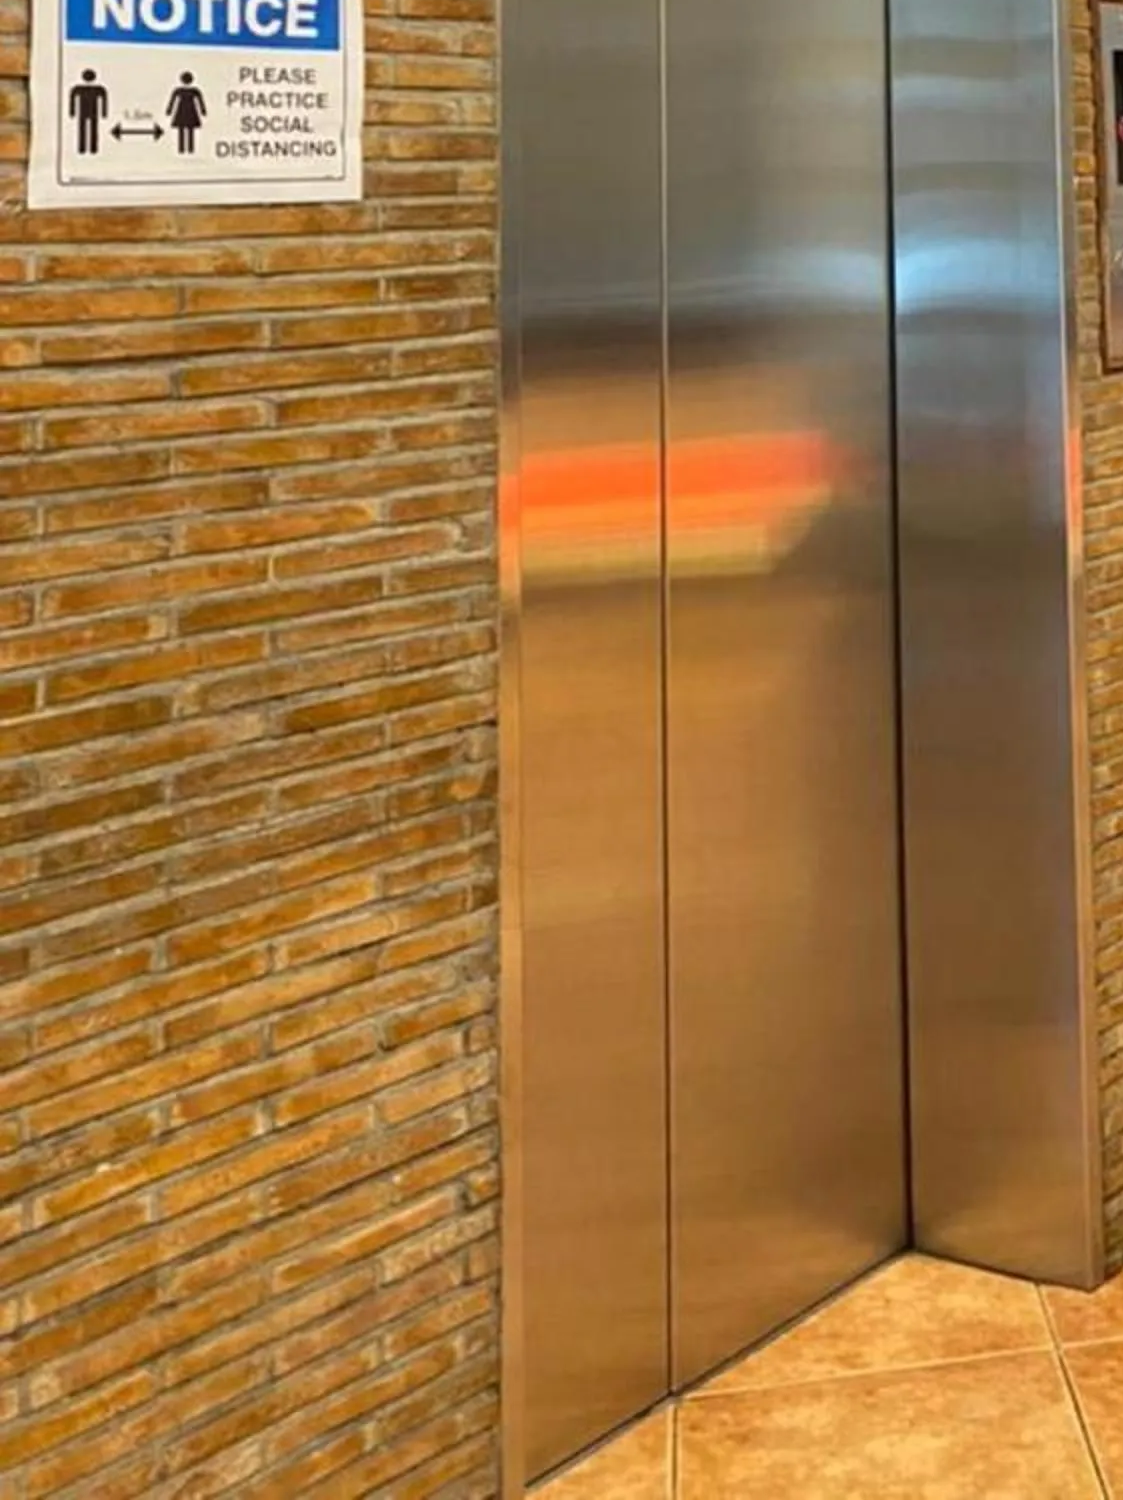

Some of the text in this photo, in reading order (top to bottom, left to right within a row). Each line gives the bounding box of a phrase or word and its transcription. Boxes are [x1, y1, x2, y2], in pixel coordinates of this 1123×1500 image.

[239, 66, 317, 86] PLEASE
[226, 91, 329, 111] PRACTICE
[240, 115, 314, 134] SOCIAL
[215, 140, 338, 159] DISTANCING
